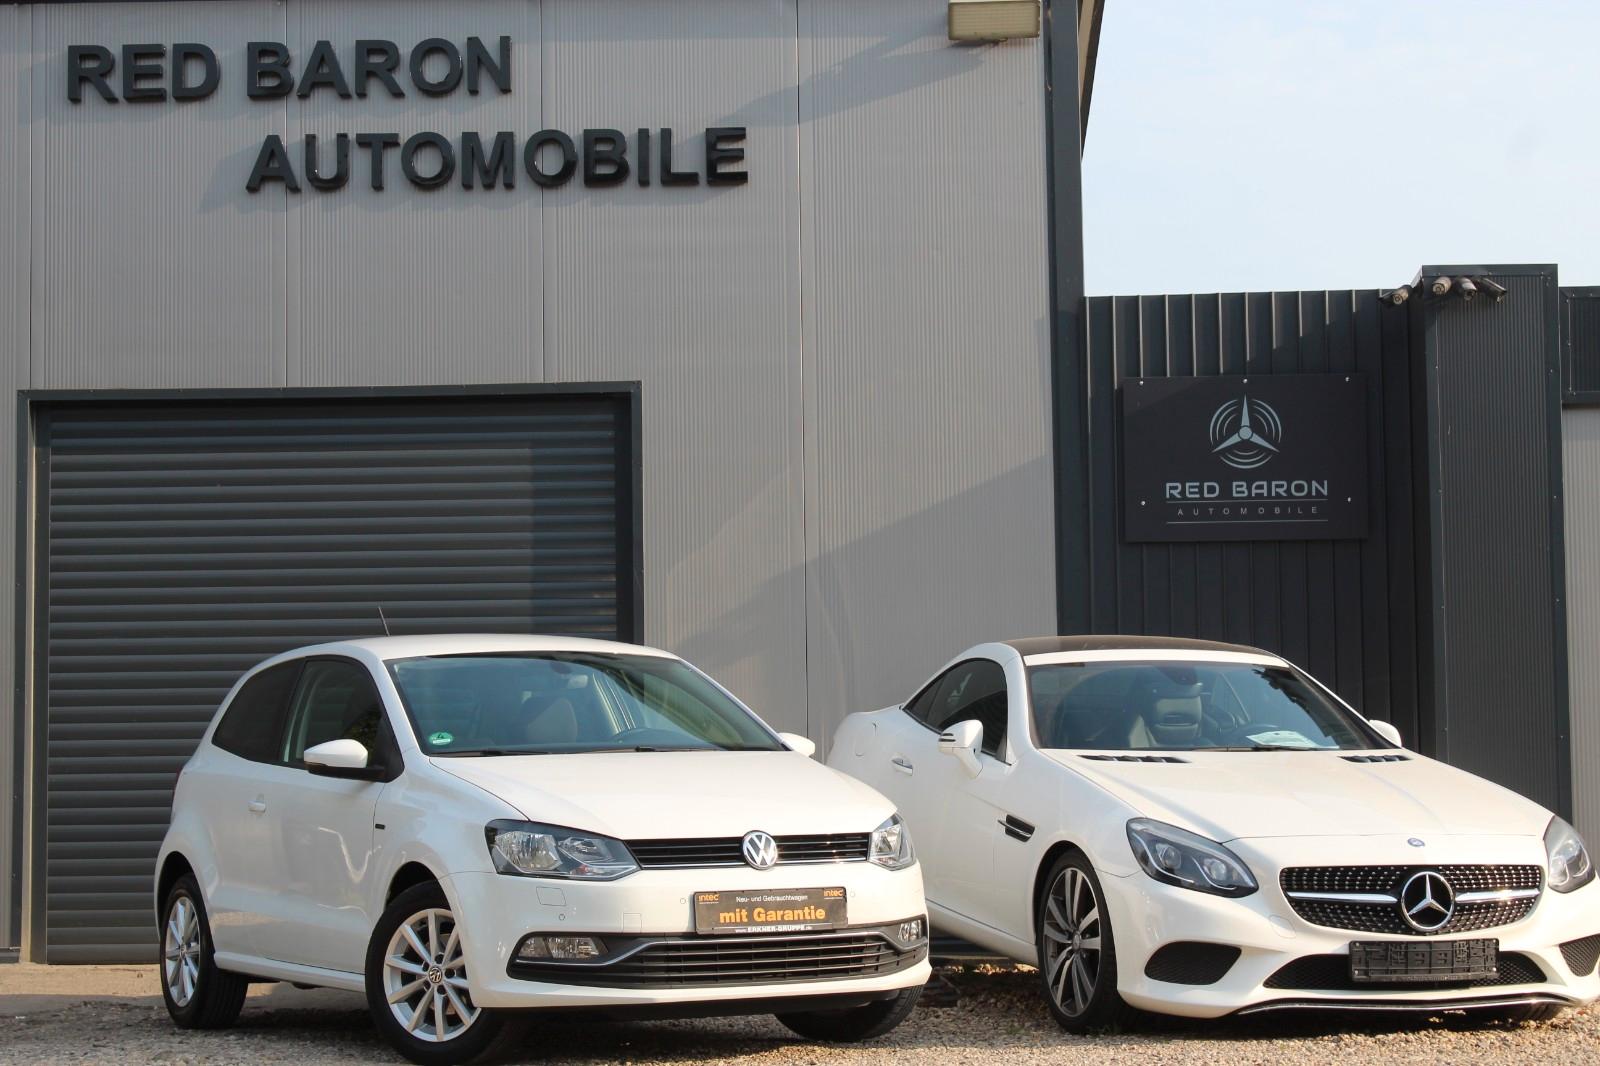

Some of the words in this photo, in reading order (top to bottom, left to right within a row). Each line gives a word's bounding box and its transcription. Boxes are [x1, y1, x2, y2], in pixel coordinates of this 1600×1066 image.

[67, 43, 220, 103] RED
[247, 36, 513, 100] BARON
[246, 127, 748, 193] AUTOMOBILE
[1166, 482, 1220, 498] RED
[1232, 480, 1328, 497] BARON
[1177, 506, 1318, 516] AUTOMOBILE
[744, 832, 777, 868] VW
[763, 894, 808, 902] Gebrauchtwagen
[719, 908, 748, 924] mit
[753, 905, 826, 922] Garantie
